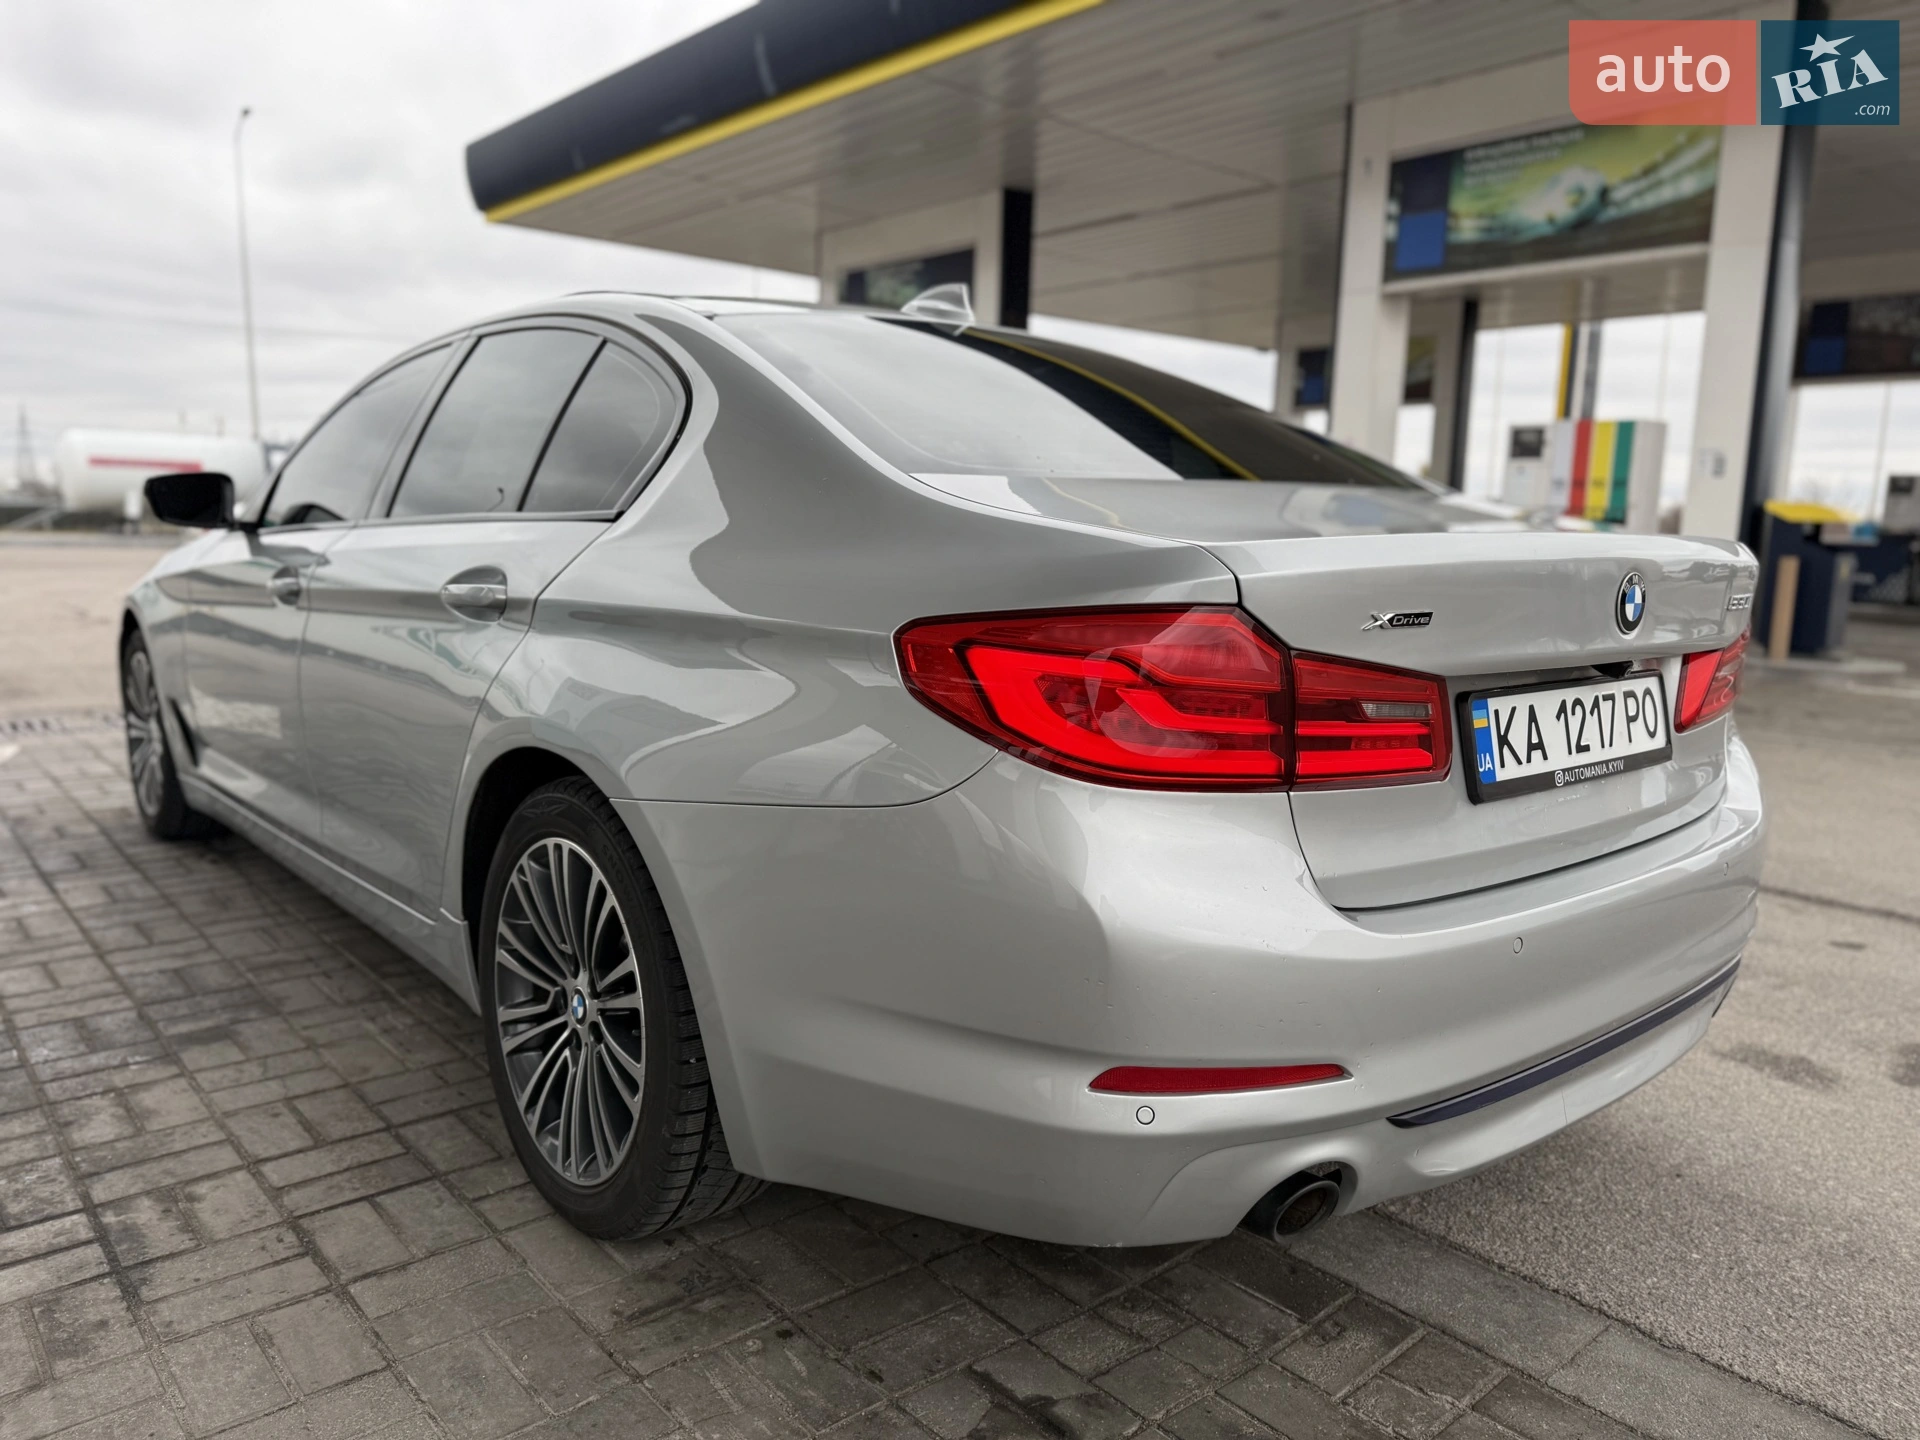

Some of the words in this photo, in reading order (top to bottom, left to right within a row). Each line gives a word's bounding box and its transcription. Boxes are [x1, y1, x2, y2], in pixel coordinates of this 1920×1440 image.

[1494, 704, 1549, 769] KA
[1555, 692, 1617, 756] 1217
[1622, 686, 1658, 744] PO
[1478, 752, 1493, 772] UA
